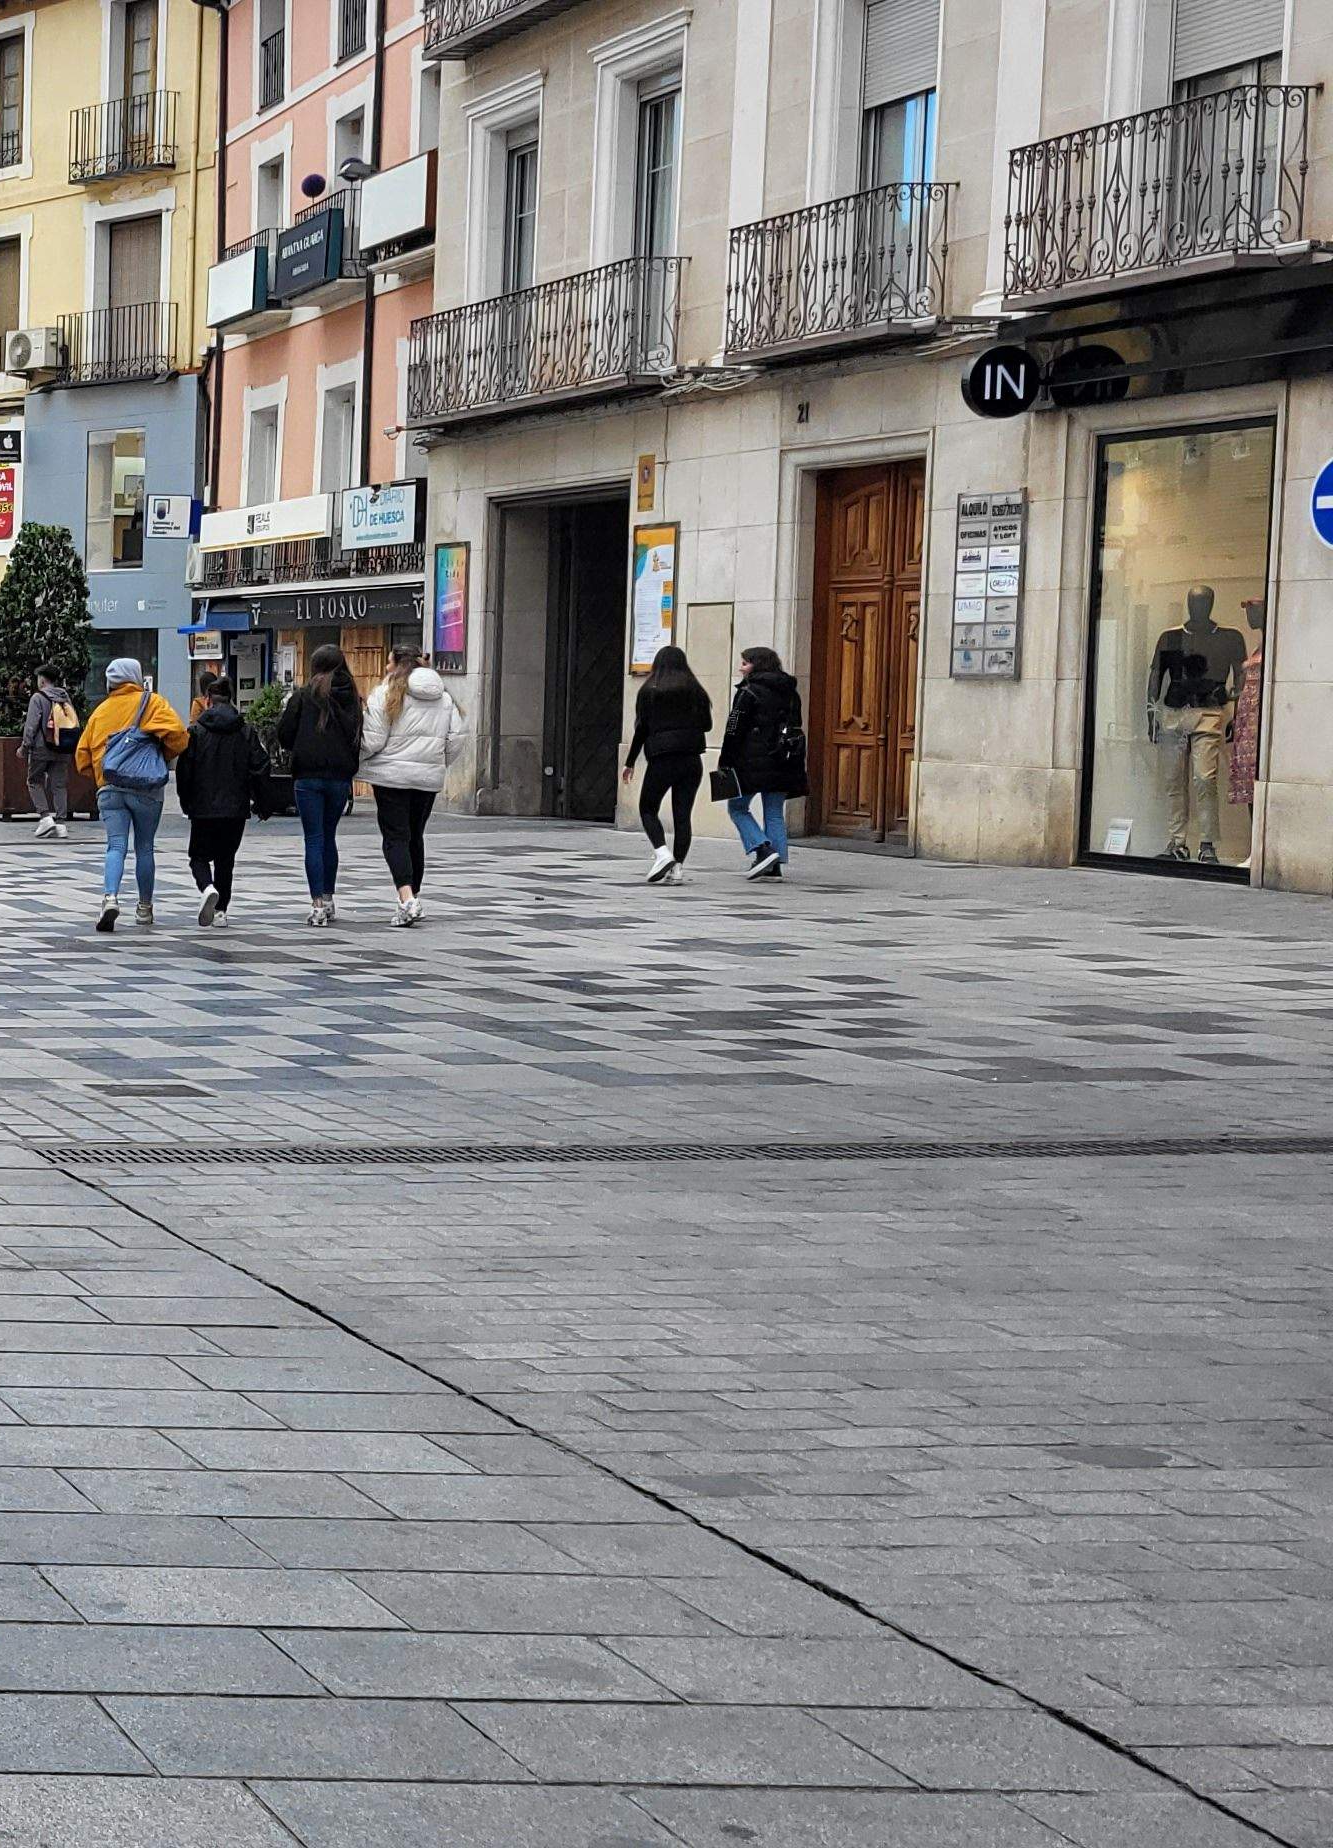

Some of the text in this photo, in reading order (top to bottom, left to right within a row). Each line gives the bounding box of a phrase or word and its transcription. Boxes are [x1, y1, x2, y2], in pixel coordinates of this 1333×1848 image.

[984, 363, 1025, 400] IN
[797, 401, 810, 424] 21
[296, 594, 367, 620] EL FOSKO
